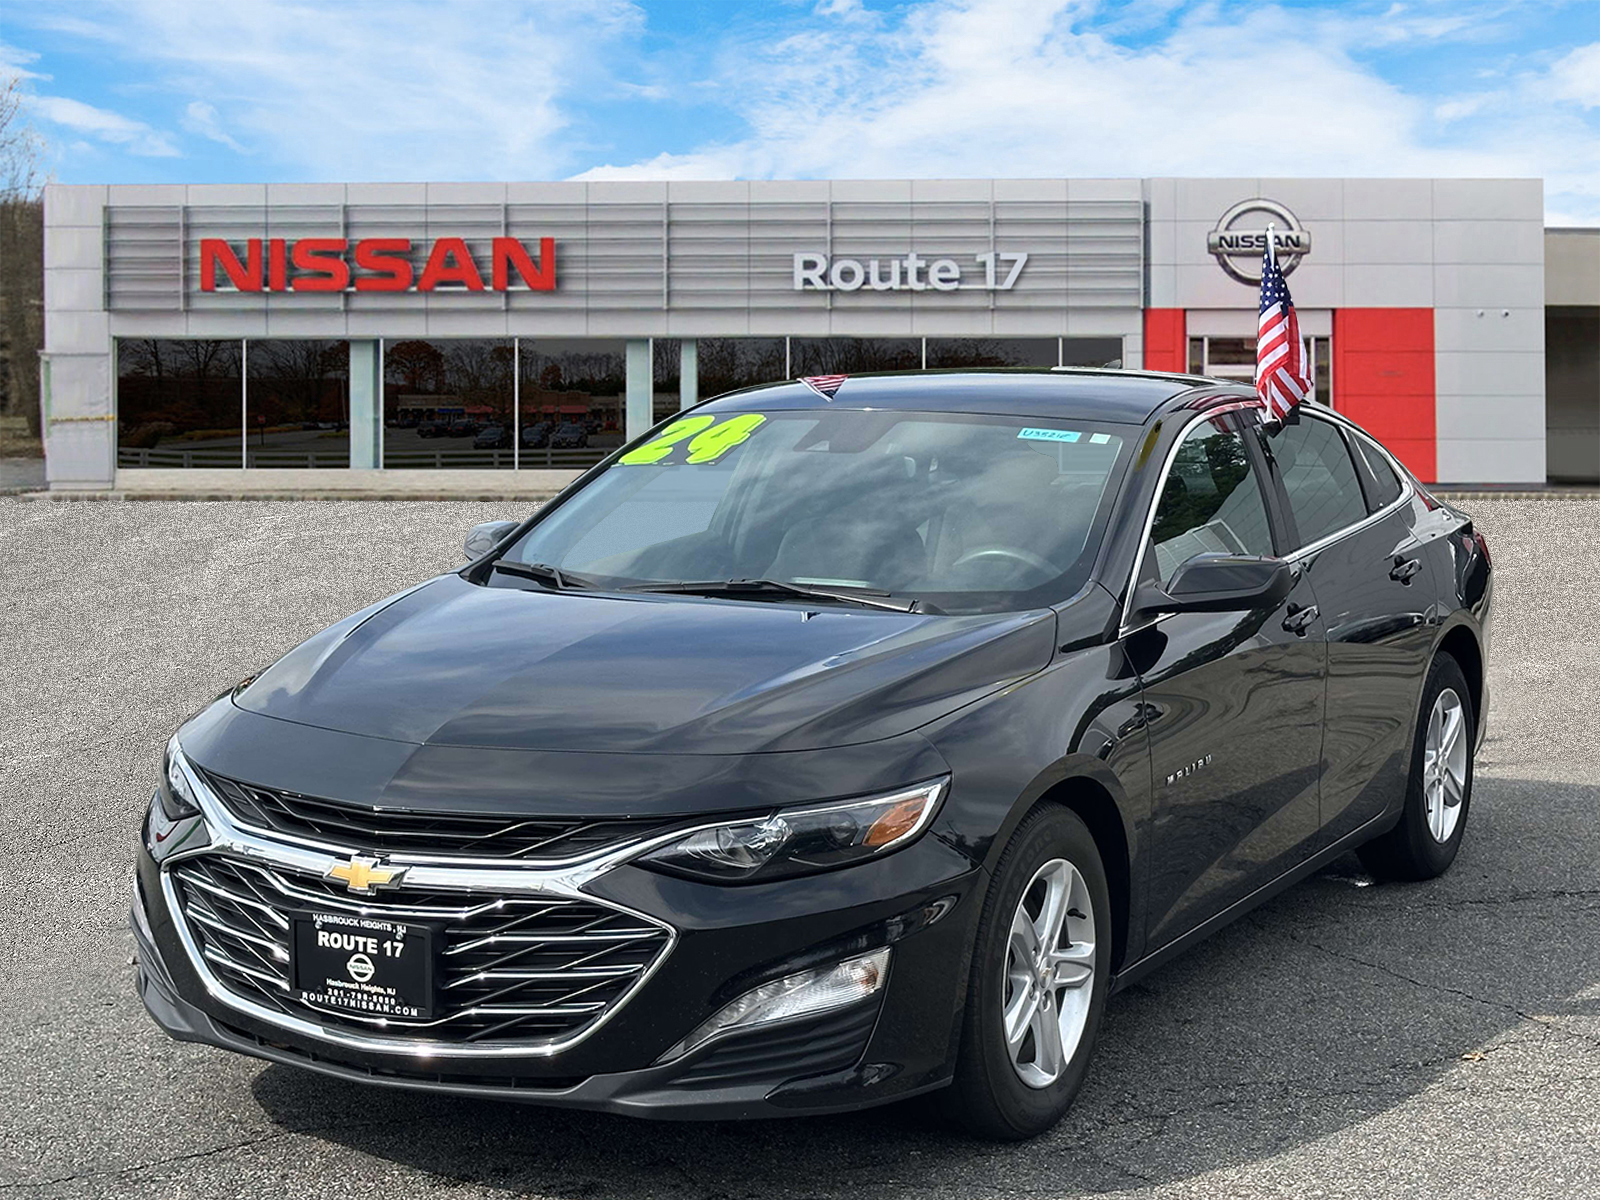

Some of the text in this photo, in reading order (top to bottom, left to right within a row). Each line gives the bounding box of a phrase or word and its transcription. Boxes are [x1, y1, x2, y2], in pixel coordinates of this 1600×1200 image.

[1219, 235, 1300, 248] NISSAN
[200, 237, 556, 292] NISSAN
[793, 252, 1029, 291] Route 17
[618, 413, 767, 465] 24
[1166, 754, 1212, 786] MALIBU
[312, 913, 359, 928] HASBROUCK
[317, 930, 405, 958] ROUTE 17
[301, 991, 418, 1017] ROUTE17NISSAN.COM
